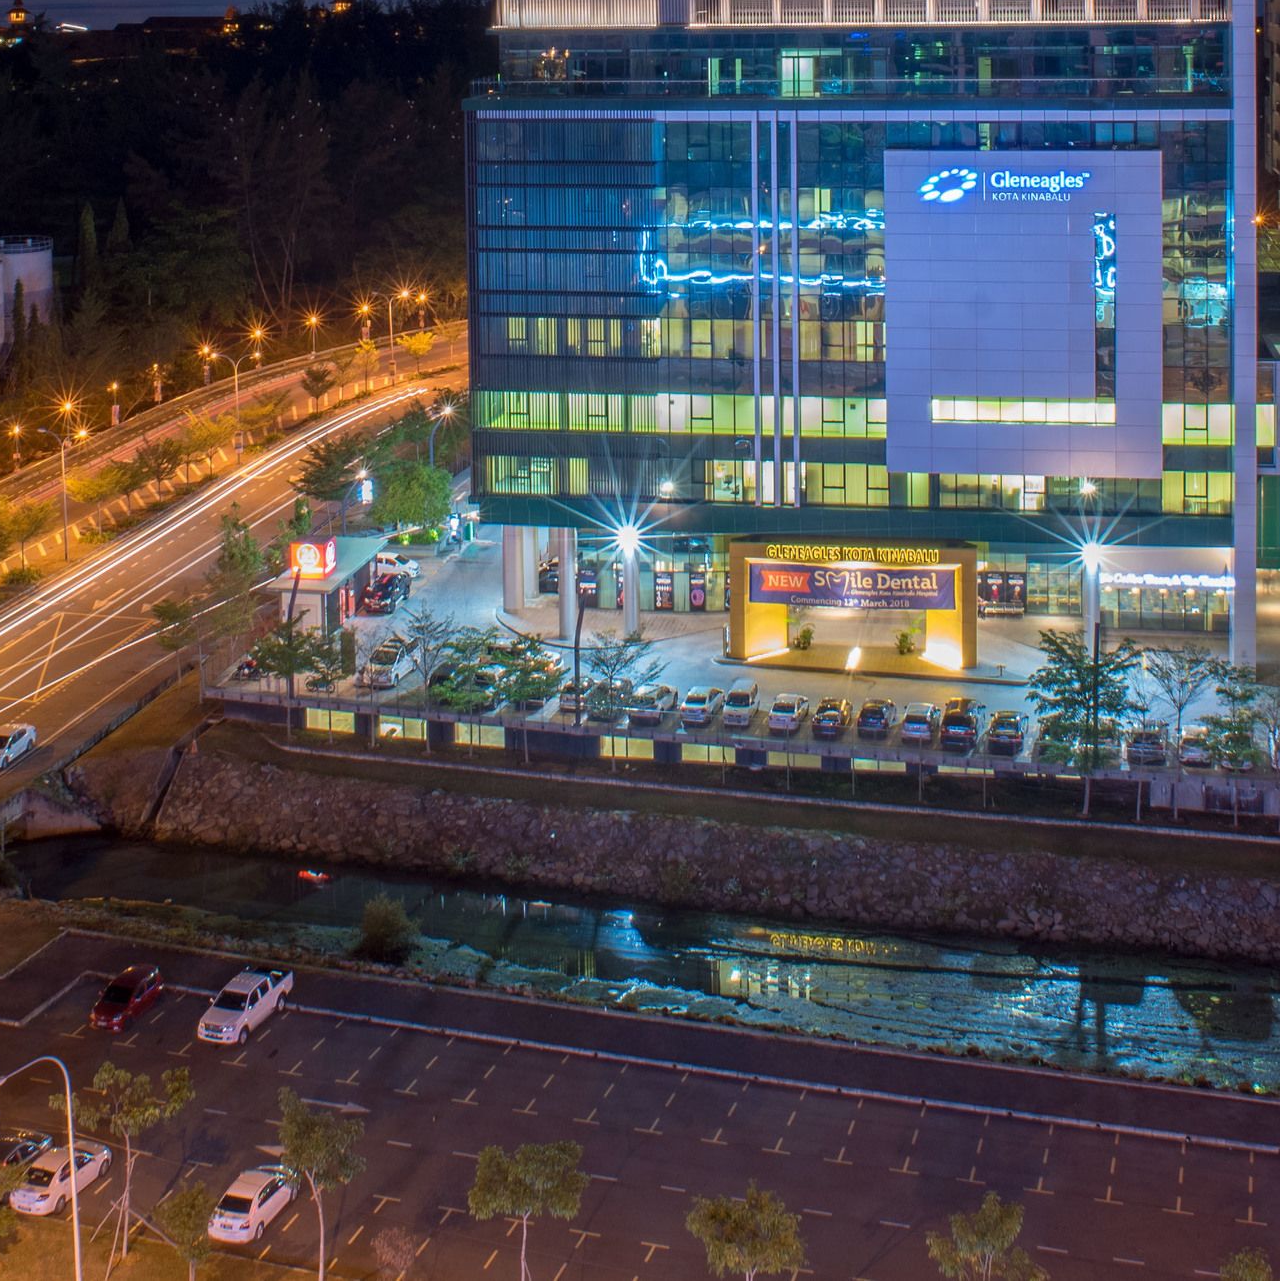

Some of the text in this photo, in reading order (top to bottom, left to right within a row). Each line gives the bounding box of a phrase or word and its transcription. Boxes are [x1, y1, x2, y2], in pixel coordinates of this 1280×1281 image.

[992, 192, 1071, 202] KOTA KINABALU
[766, 545, 939, 564] GLENEAGLES KOTA KINABALU
[768, 574, 804, 588] NEW
[877, 572, 938, 590] Dental
[790, 595, 841, 607] Commencing
[860, 598, 887, 608] March
[889, 599, 910, 608] 2018
